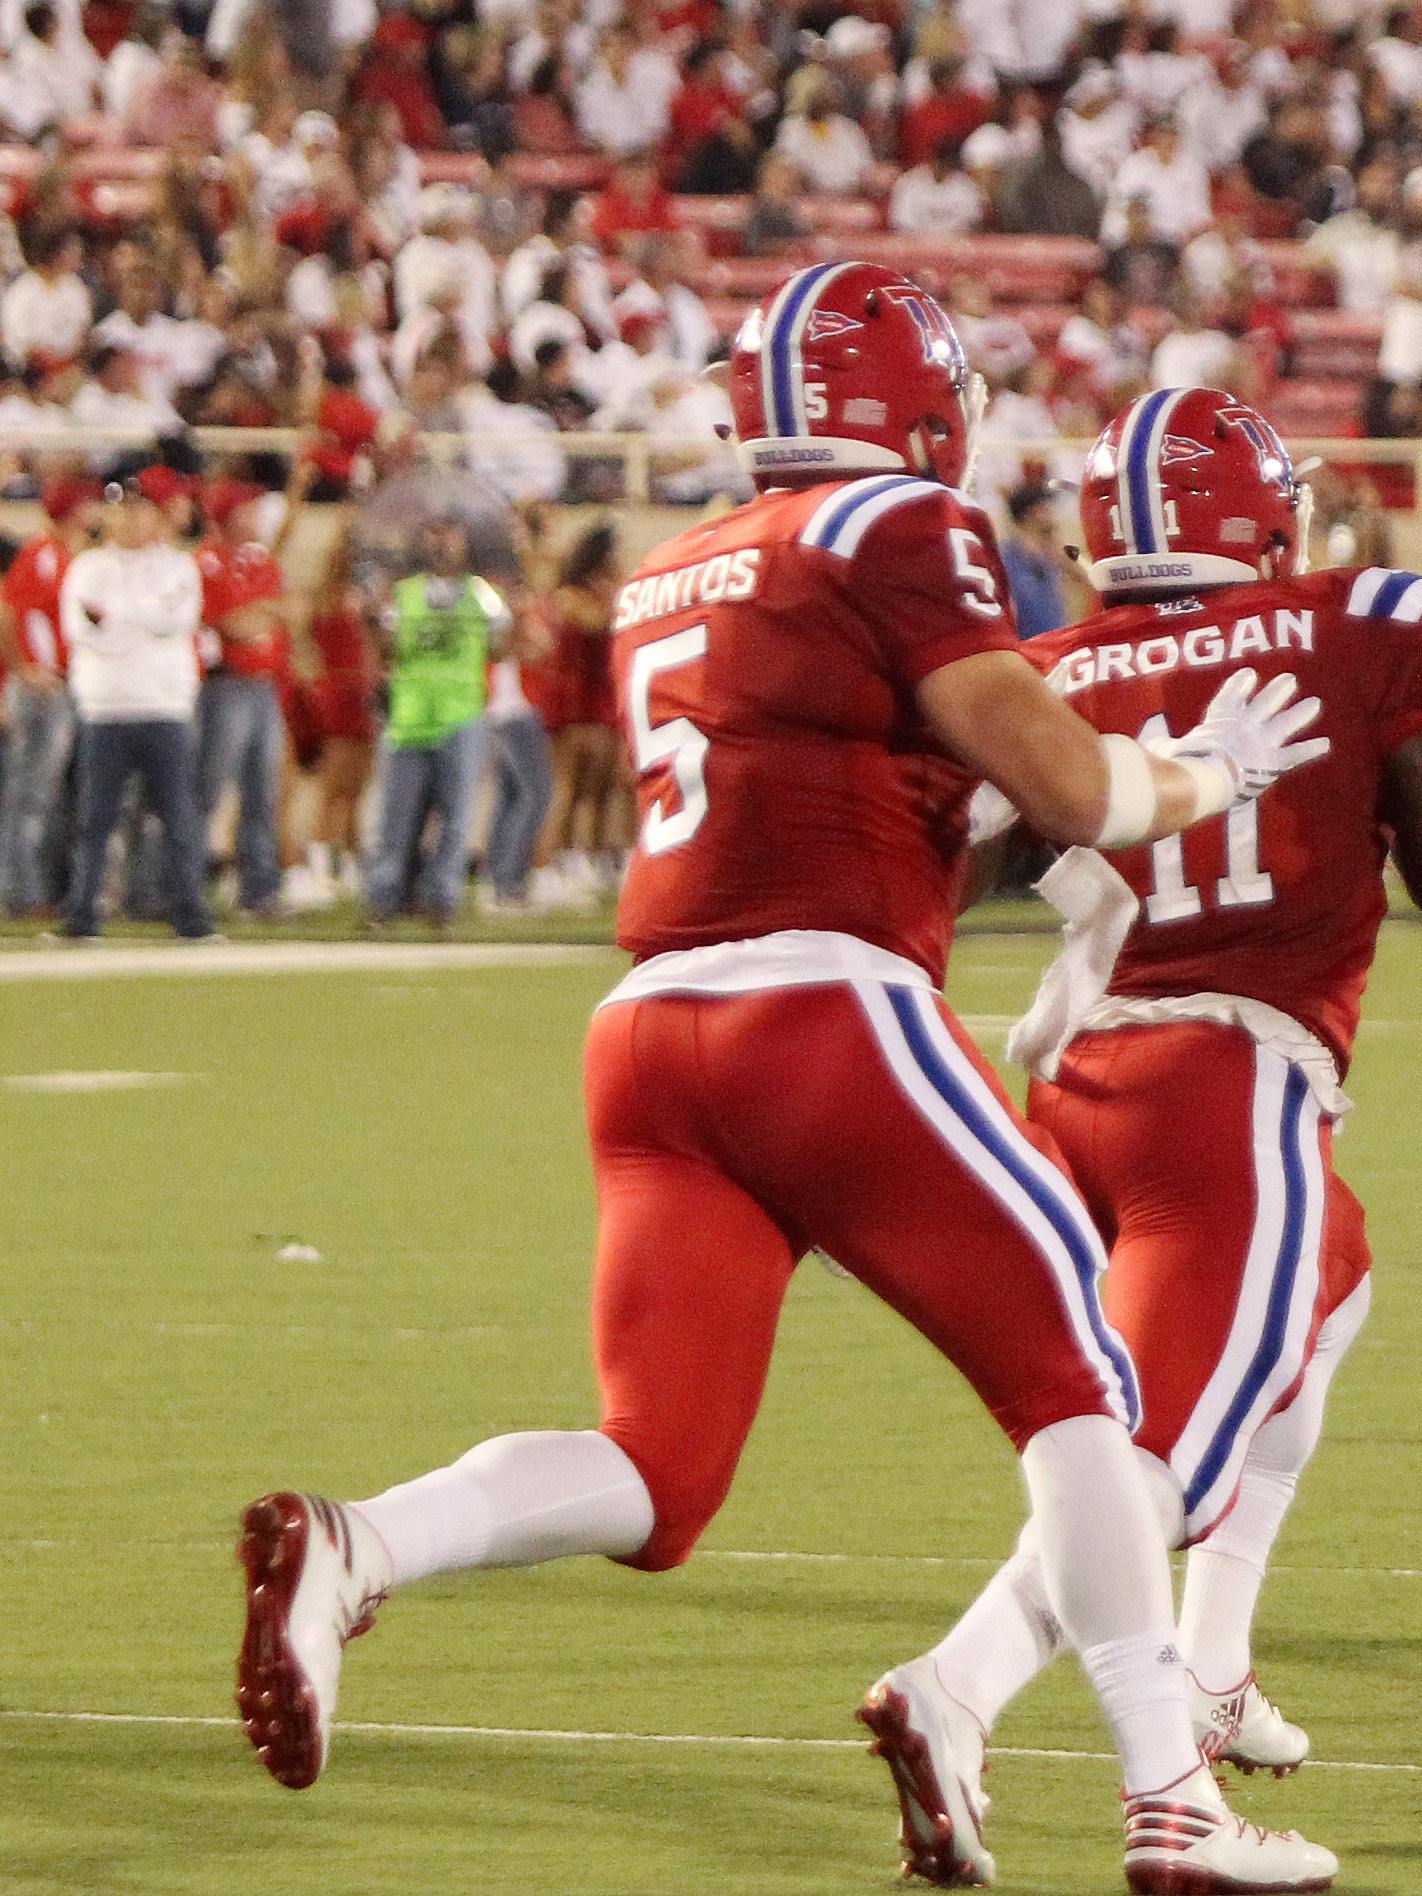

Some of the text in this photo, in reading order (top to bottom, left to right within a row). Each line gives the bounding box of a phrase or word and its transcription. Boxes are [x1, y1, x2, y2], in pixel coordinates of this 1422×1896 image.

[803, 382, 829, 420] 5
[615, 548, 761, 631] SANTOS
[948, 527, 1002, 617] 5
[1108, 563, 1193, 583] BULLDOGS
[1056, 608, 1315, 696] GROGAN
[630, 622, 710, 857] 5
